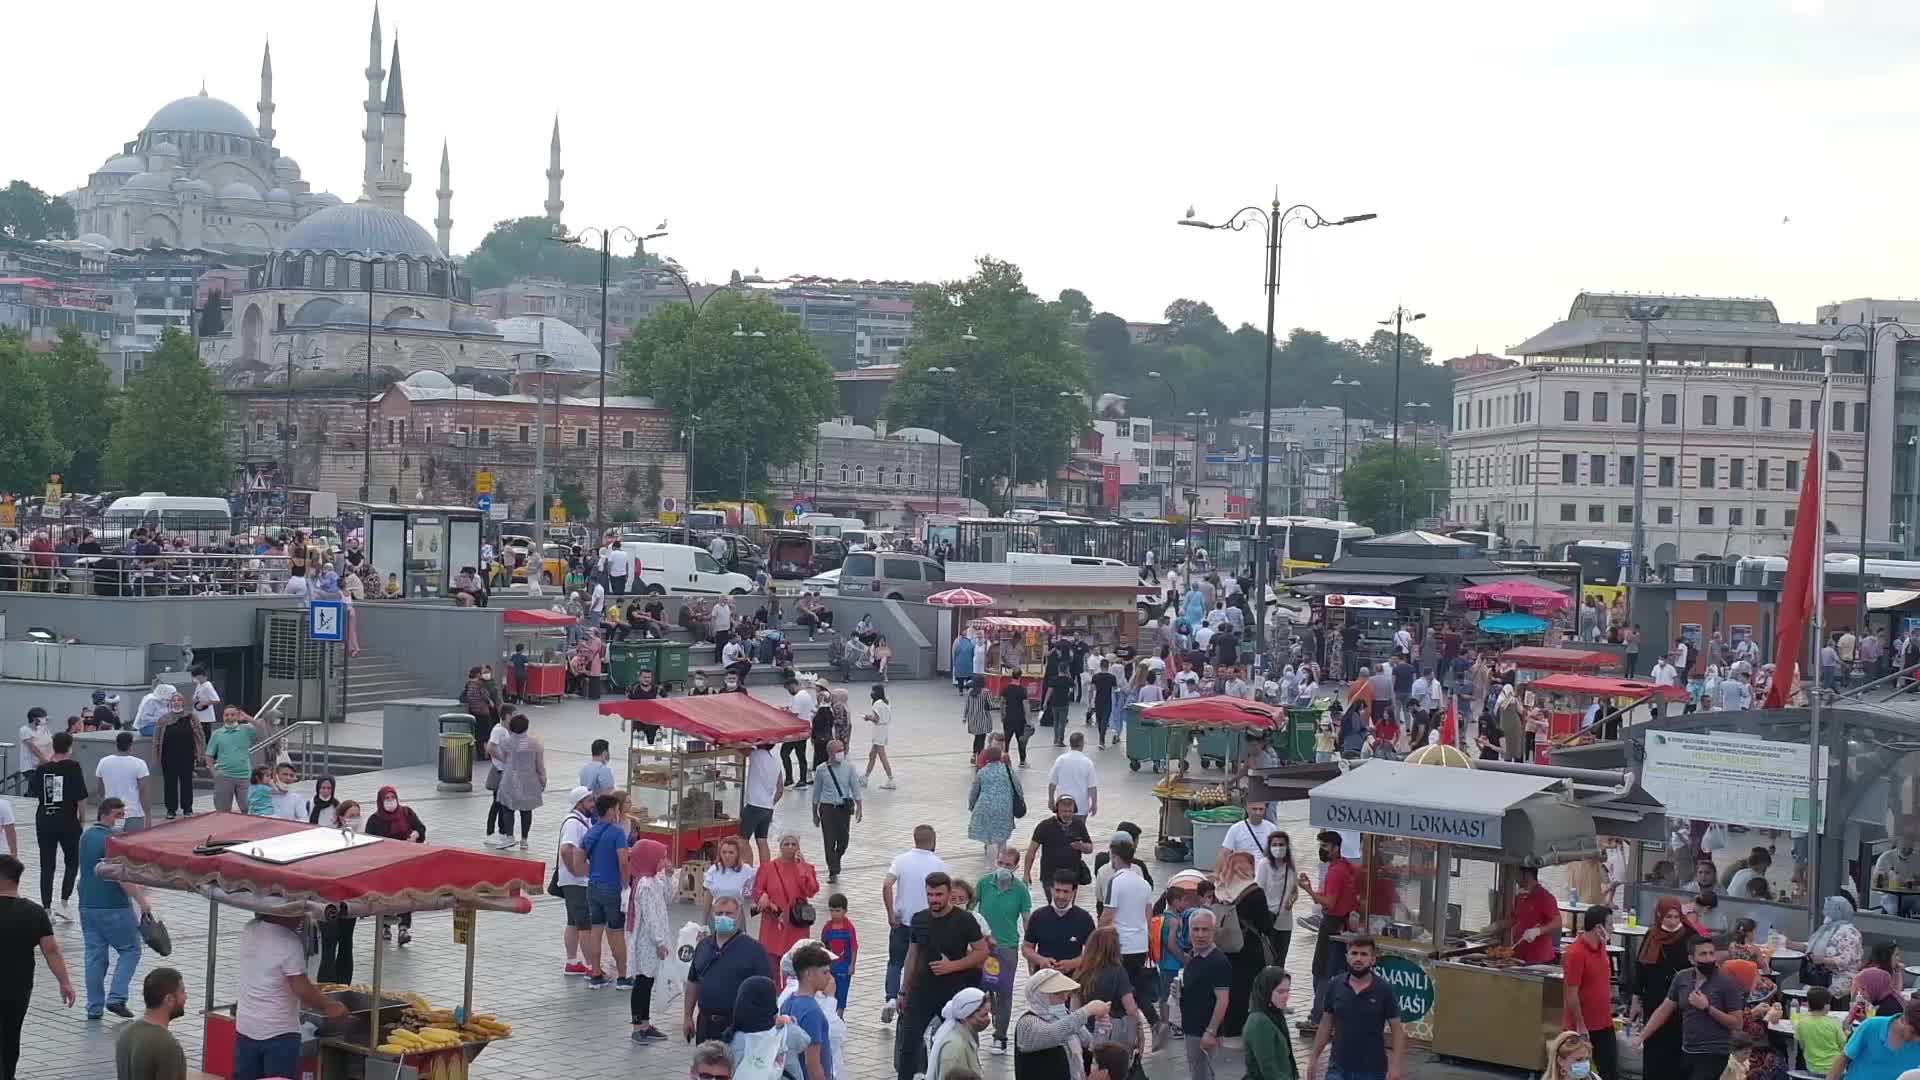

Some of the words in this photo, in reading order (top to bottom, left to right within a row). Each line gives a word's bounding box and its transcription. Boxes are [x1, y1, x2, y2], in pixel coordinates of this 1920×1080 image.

[1327, 804, 1400, 828] OSMANLI
[1410, 814, 1486, 838] LOKMASI
[1370, 965, 1428, 991] SMANLI
